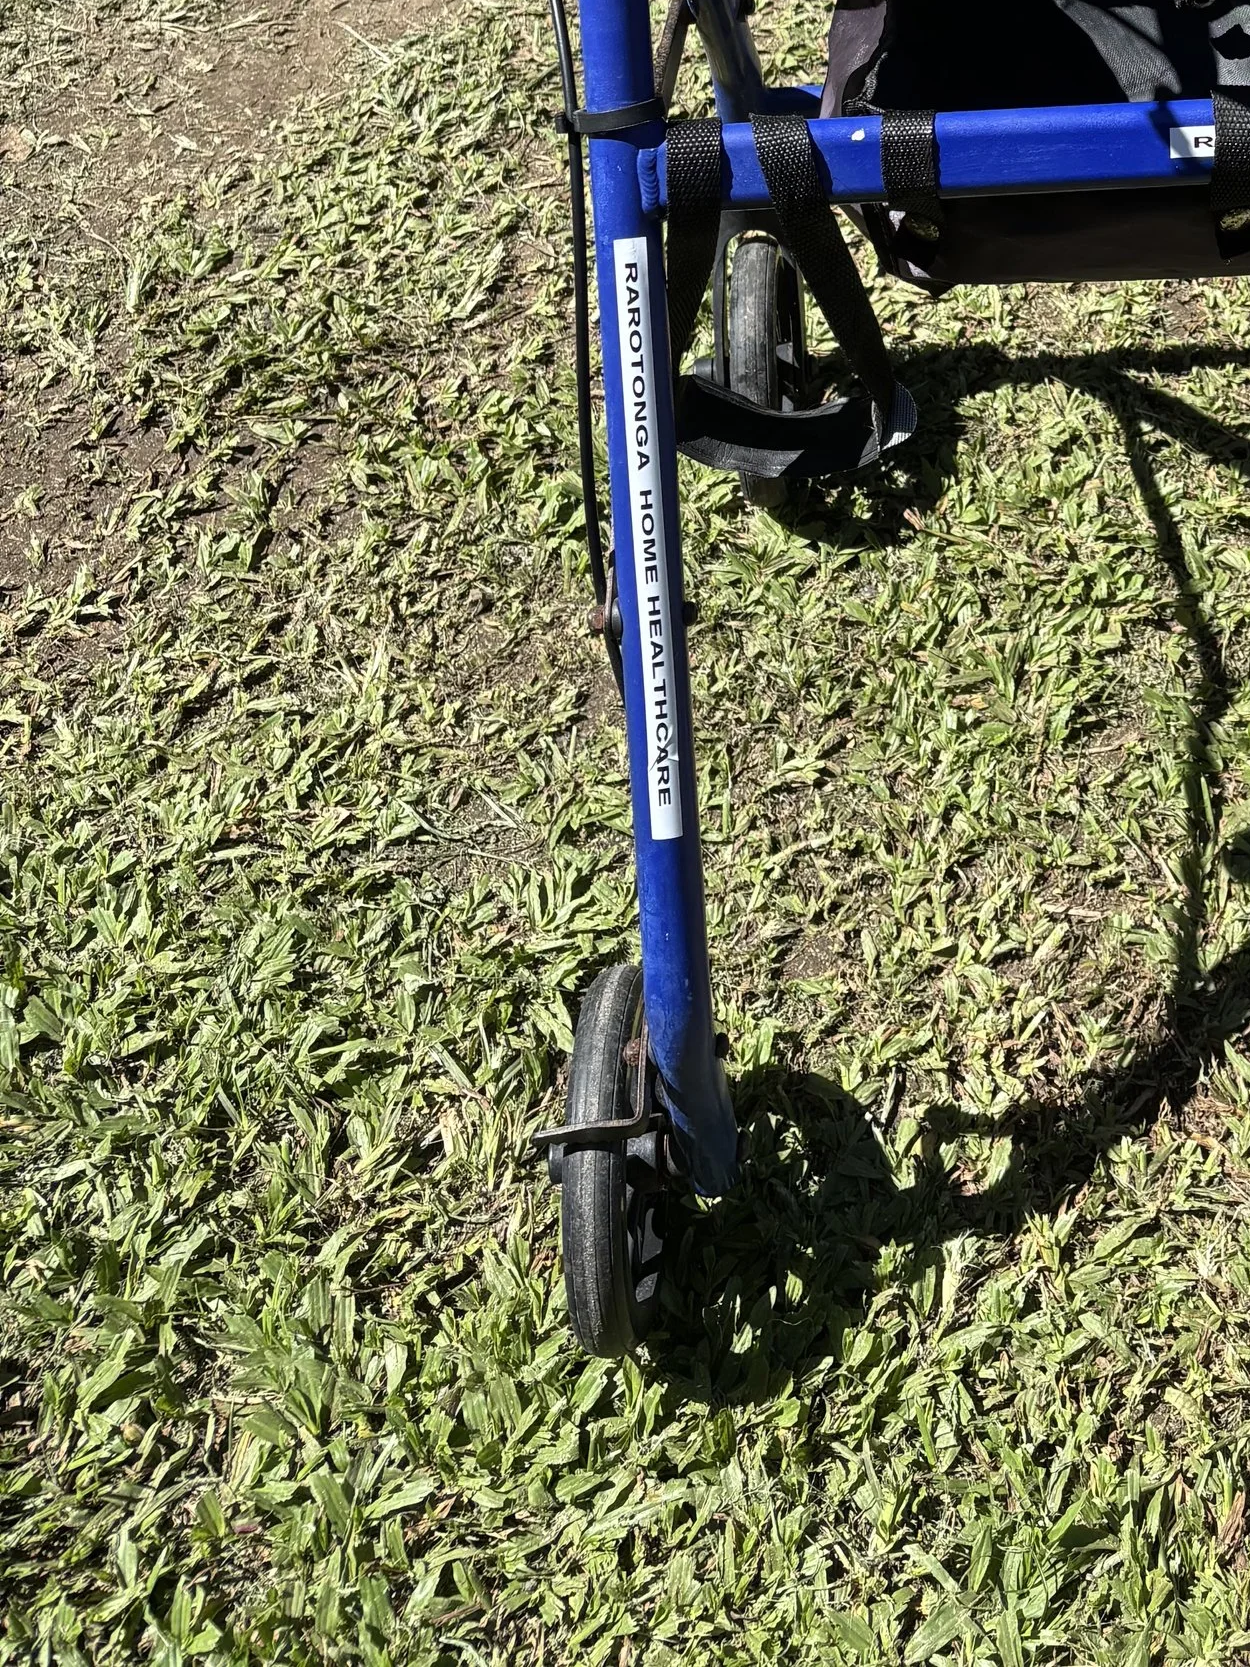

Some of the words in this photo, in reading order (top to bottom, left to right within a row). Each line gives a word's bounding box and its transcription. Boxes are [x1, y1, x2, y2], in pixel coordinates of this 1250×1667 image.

[624, 262, 650, 470] RAROTONGA
[639, 489, 659, 585] HOME
[647, 595, 671, 808] HEALTHCARE
